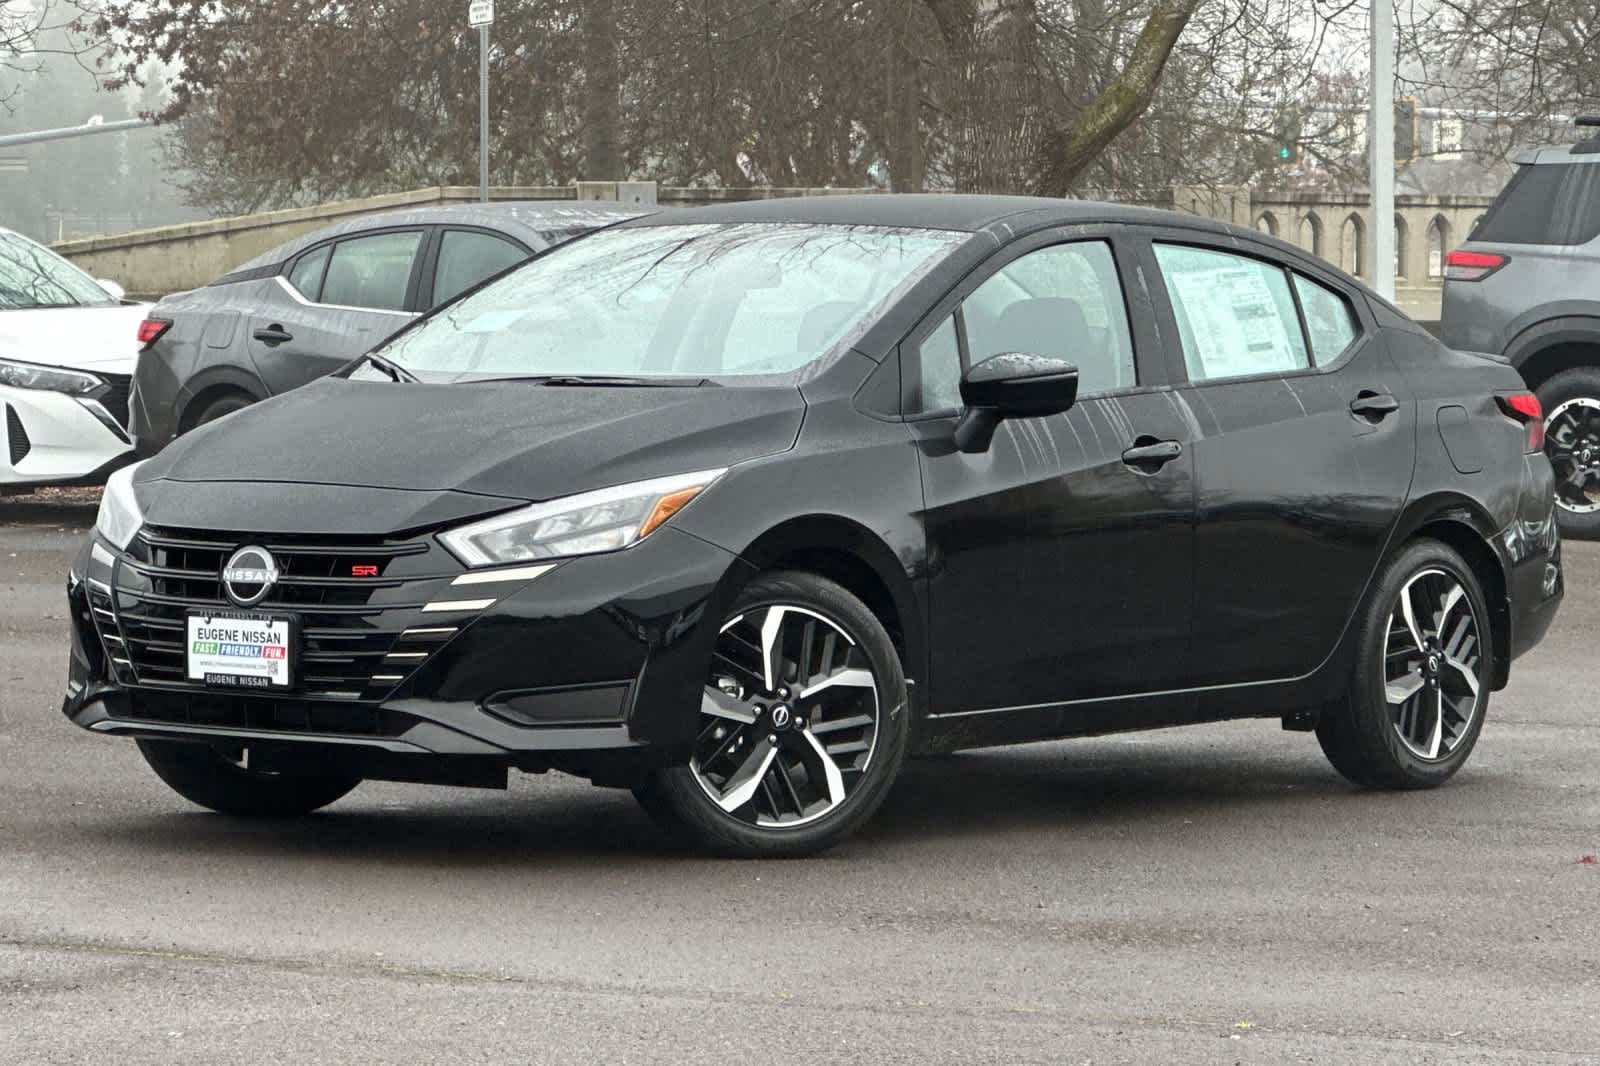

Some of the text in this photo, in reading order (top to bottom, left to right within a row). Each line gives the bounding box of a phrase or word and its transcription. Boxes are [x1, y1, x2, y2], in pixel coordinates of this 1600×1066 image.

[223, 569, 277, 582] NISSAN
[352, 565, 378, 576] SR
[197, 627, 281, 644] EUGENE NISSAN
[206, 674, 269, 687] EUGENE NISSAN
